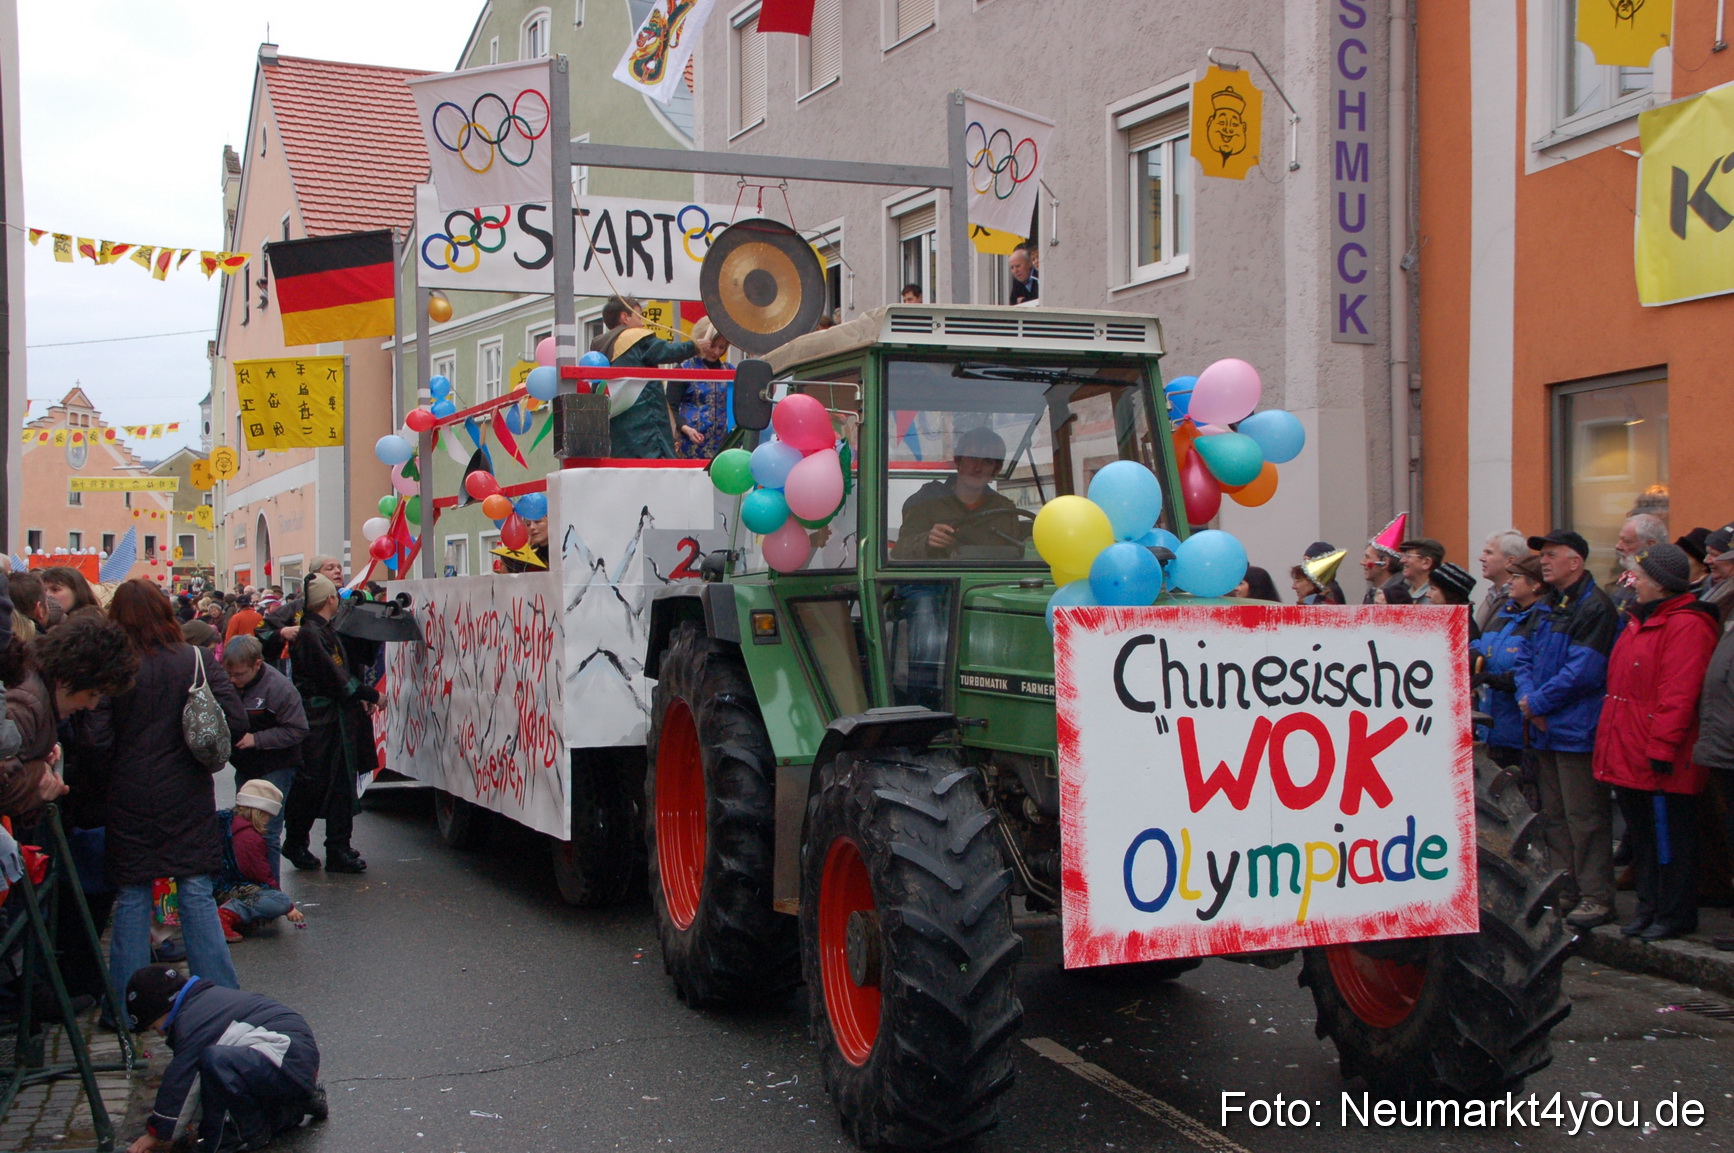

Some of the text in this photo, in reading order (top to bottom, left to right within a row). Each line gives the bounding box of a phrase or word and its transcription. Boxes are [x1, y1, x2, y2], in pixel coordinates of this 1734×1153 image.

[1334, 0, 1370, 336] SCHMUCK
[513, 203, 676, 285] START
[960, 675, 1055, 696] TURBOMATIK FARMER
[1113, 633, 1434, 713] Chinesische
[1123, 815, 1449, 926] Olympiade
